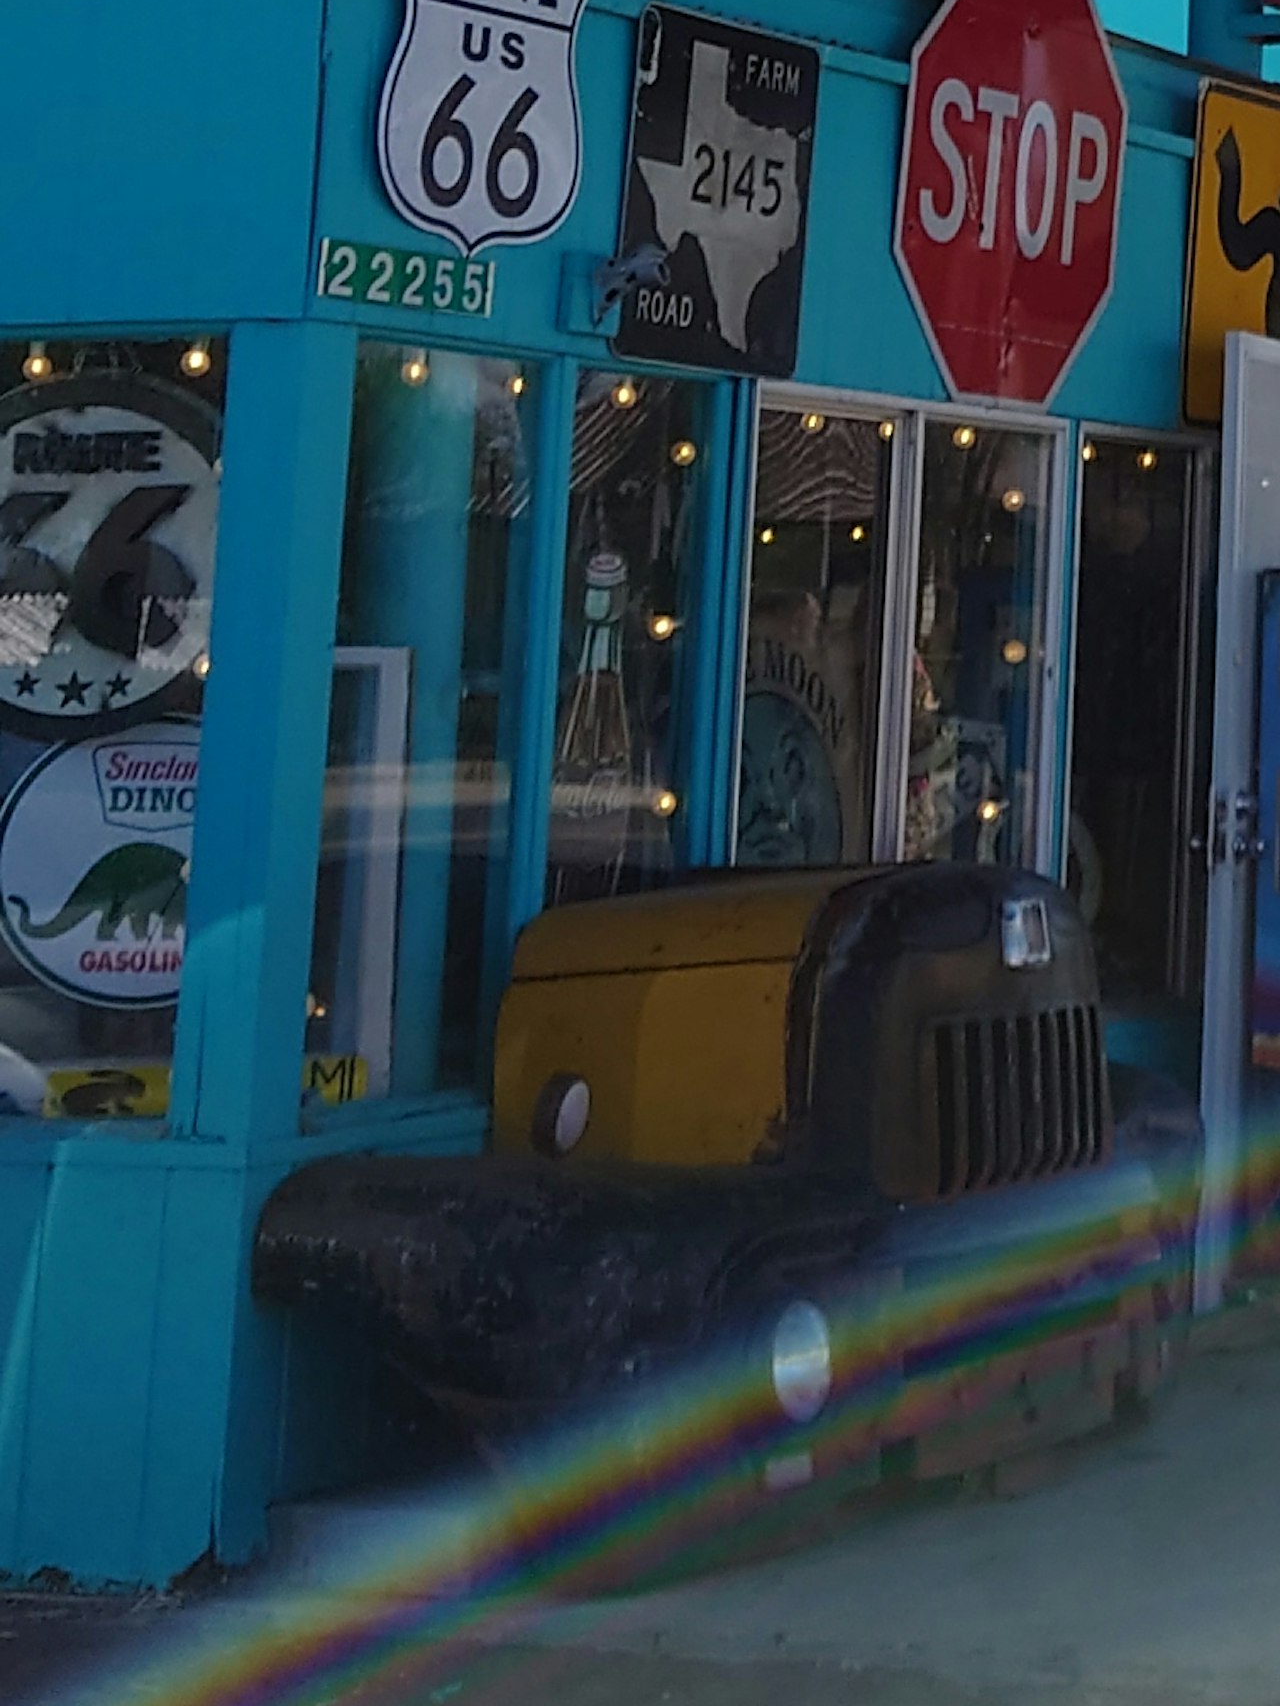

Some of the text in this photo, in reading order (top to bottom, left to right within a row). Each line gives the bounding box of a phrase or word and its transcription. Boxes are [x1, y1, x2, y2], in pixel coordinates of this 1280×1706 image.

[462, 22, 526, 71] US
[743, 53, 800, 97] FARM
[419, 73, 540, 218] 66
[918, 77, 1109, 267] STOP
[690, 141, 784, 218] 2145
[325, 244, 488, 312] 22255
[635, 288, 695, 330] ROAD
[79, 949, 183, 973] GASOLIN
